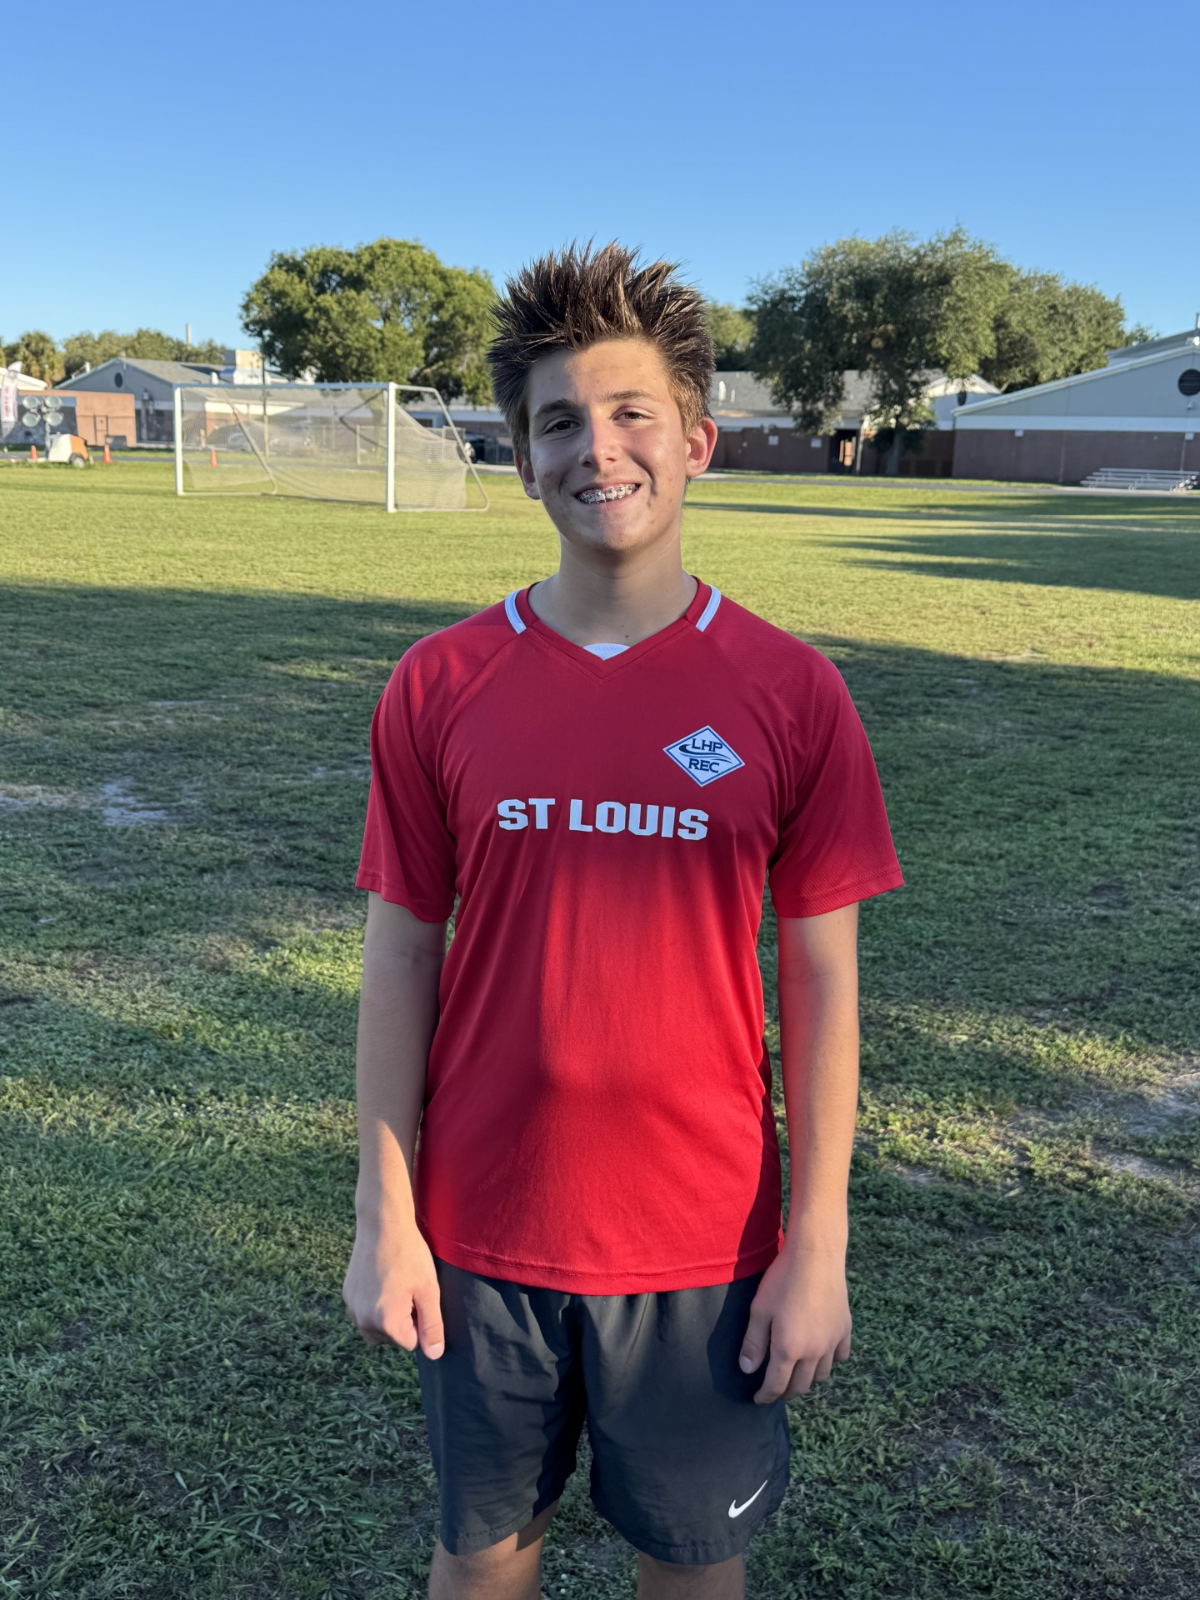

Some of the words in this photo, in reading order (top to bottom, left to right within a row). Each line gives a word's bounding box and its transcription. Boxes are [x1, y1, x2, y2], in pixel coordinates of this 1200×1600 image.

[691, 738, 723, 752] LHP
[688, 757, 720, 774] REC
[497, 798, 556, 831] ST
[569, 799, 709, 841] LOUIS
